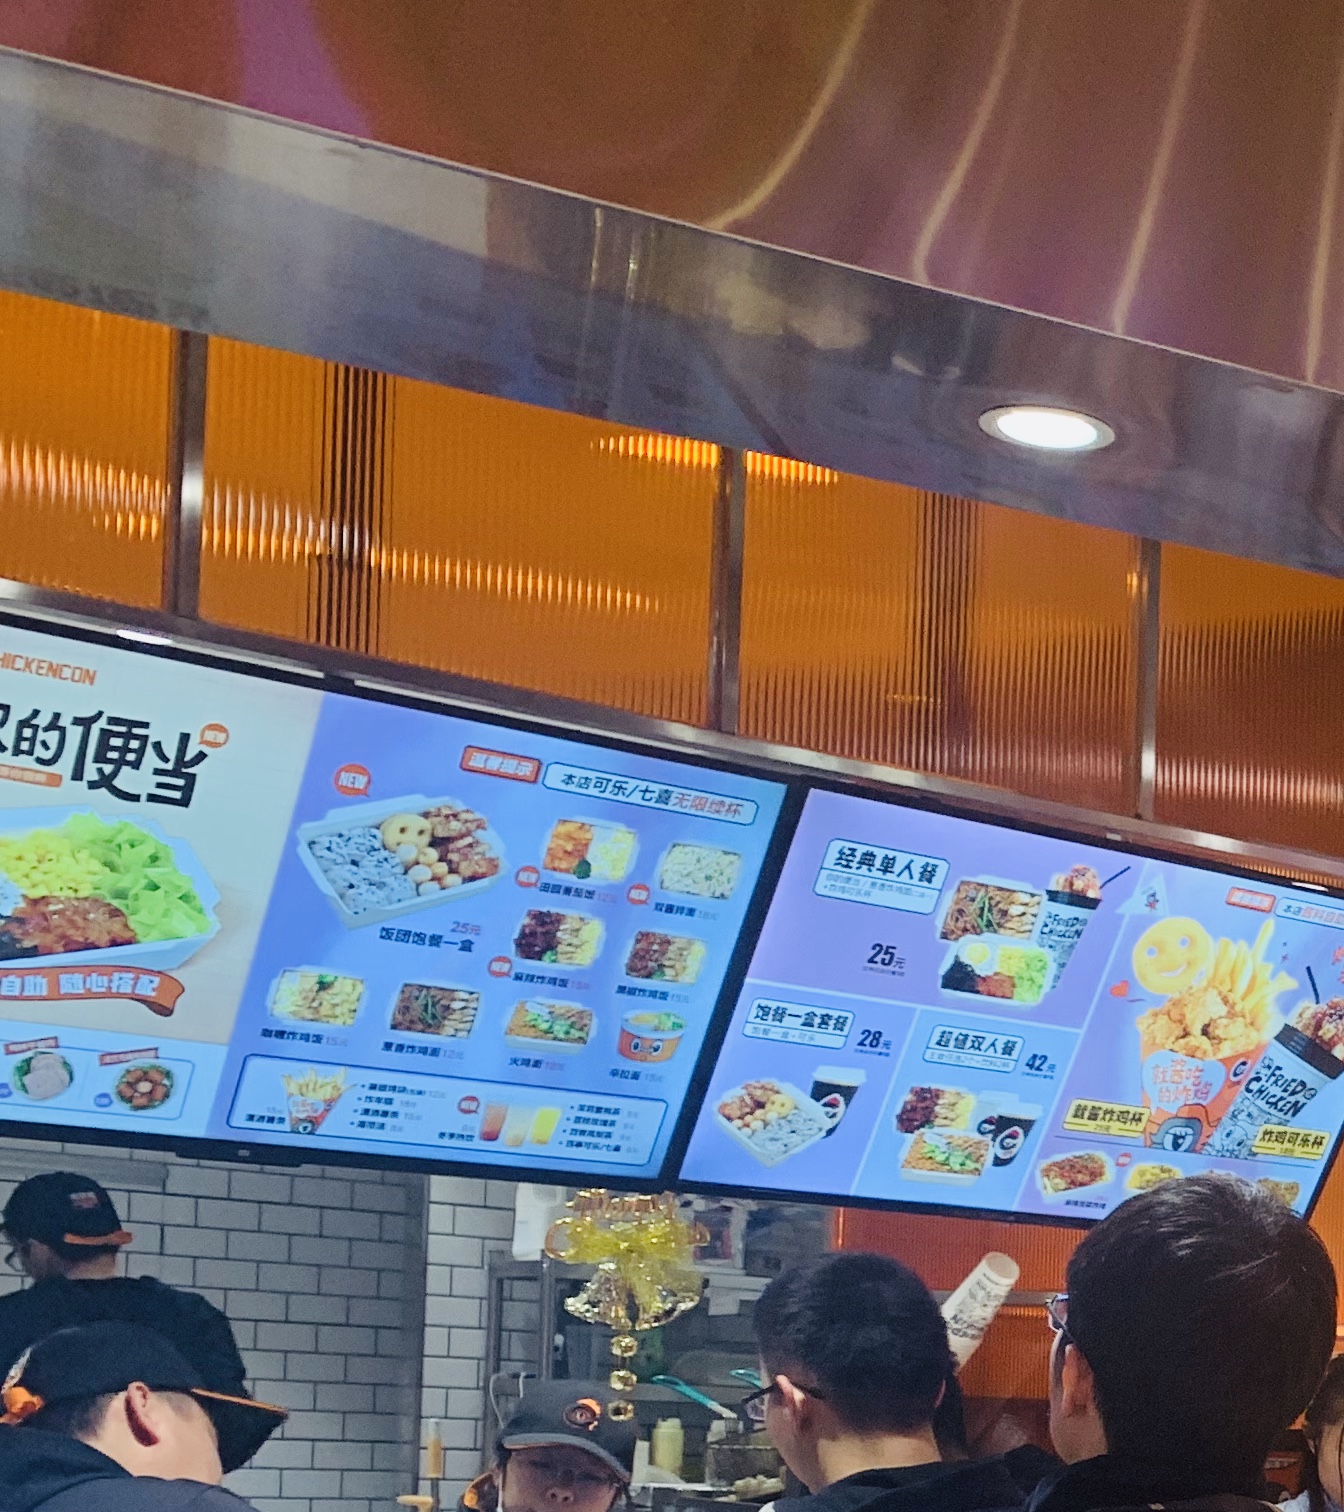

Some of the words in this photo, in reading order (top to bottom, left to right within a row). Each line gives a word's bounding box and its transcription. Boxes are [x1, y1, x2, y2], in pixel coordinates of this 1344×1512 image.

[560, 771, 745, 818] 本店可乐/七喜无限续杯
[833, 845, 939, 884] 经典单人餐
[378, 926, 475, 952] 饭团饱餐一盒
[450, 920, 482, 936] 25元
[867, 942, 906, 969] 25元
[58, 971, 161, 997] 随心搭配
[753, 1003, 849, 1032] 饱餐一盒套餐
[857, 1028, 892, 1050] 28元
[935, 1030, 1018, 1057] 超值双人餐
[1025, 1053, 1057, 1073] 42元
[1267, 1063, 1310, 1097] FRIED
[1243, 1076, 1308, 1119] CHICKEN
[1070, 1102, 1147, 1127] 就酱炸鸡杯
[1258, 1128, 1328, 1150] 炸鸡可乐杯
